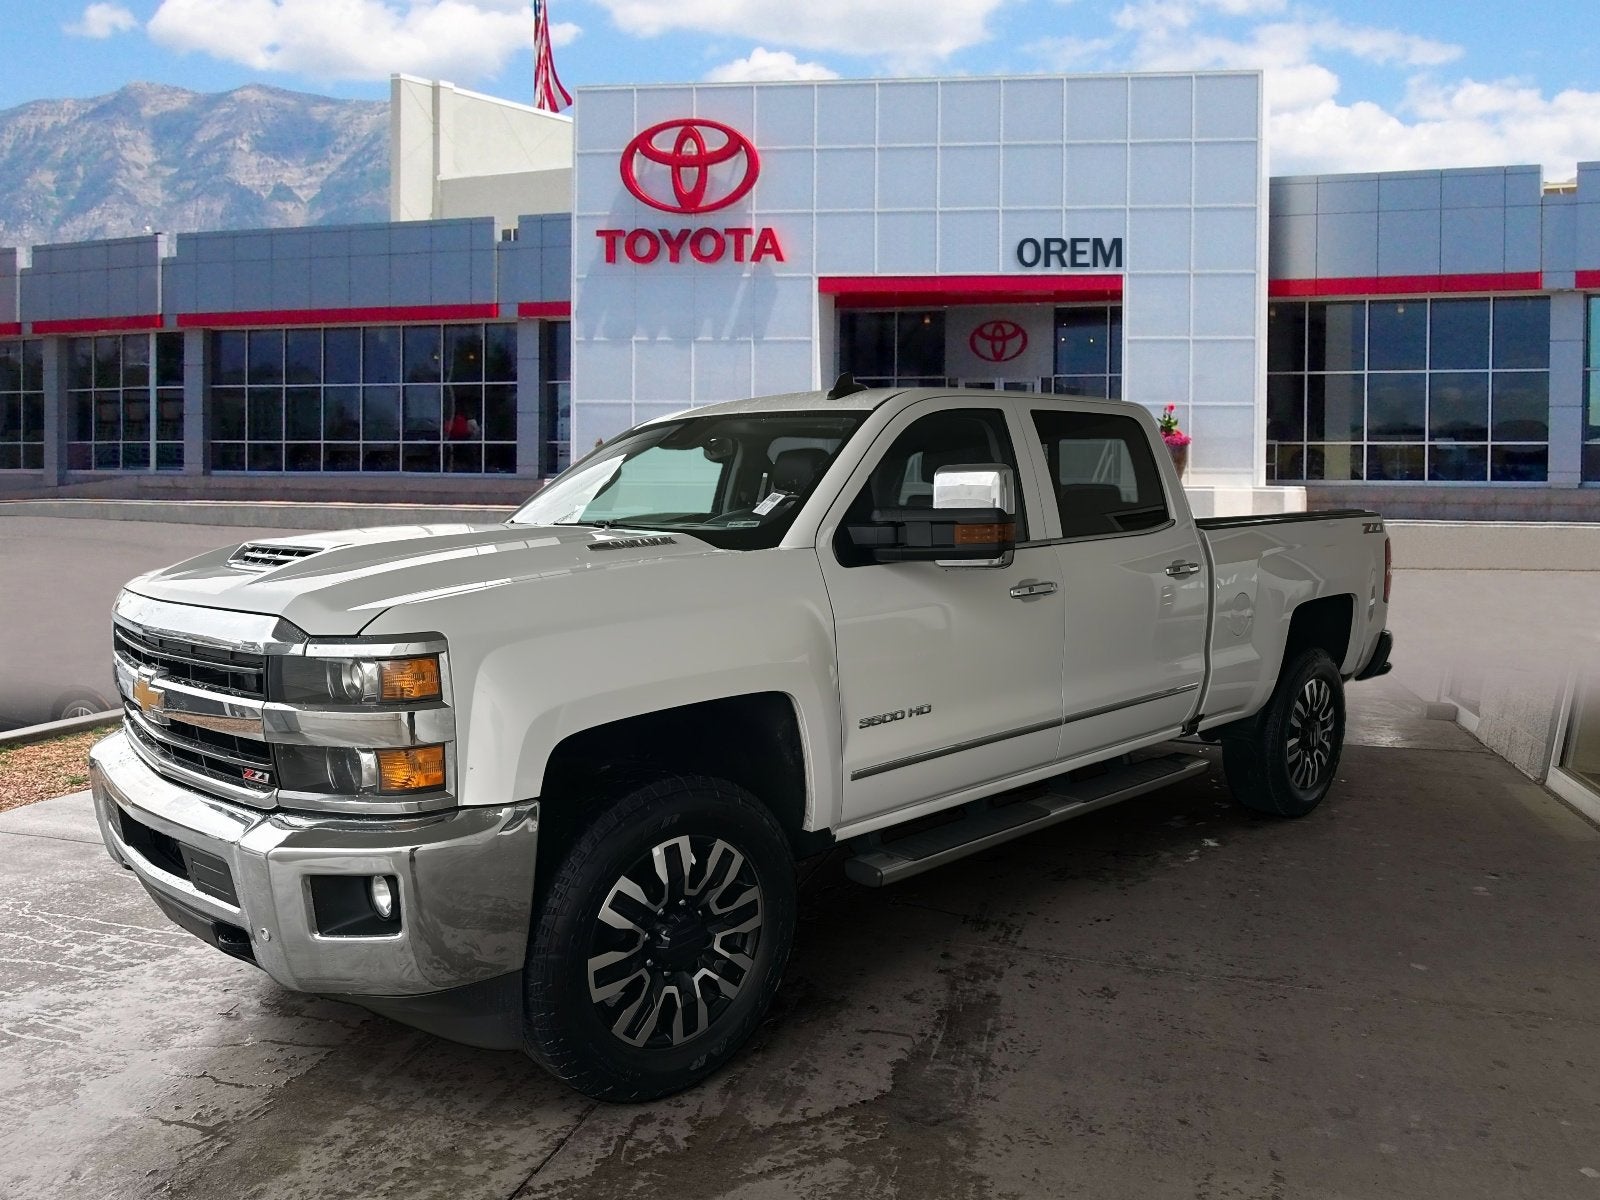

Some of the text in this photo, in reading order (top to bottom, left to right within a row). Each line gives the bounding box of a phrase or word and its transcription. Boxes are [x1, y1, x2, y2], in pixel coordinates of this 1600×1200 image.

[596, 227, 785, 264] TOYOTA
[1017, 237, 1123, 268] OREM
[908, 703, 932, 718] HD
